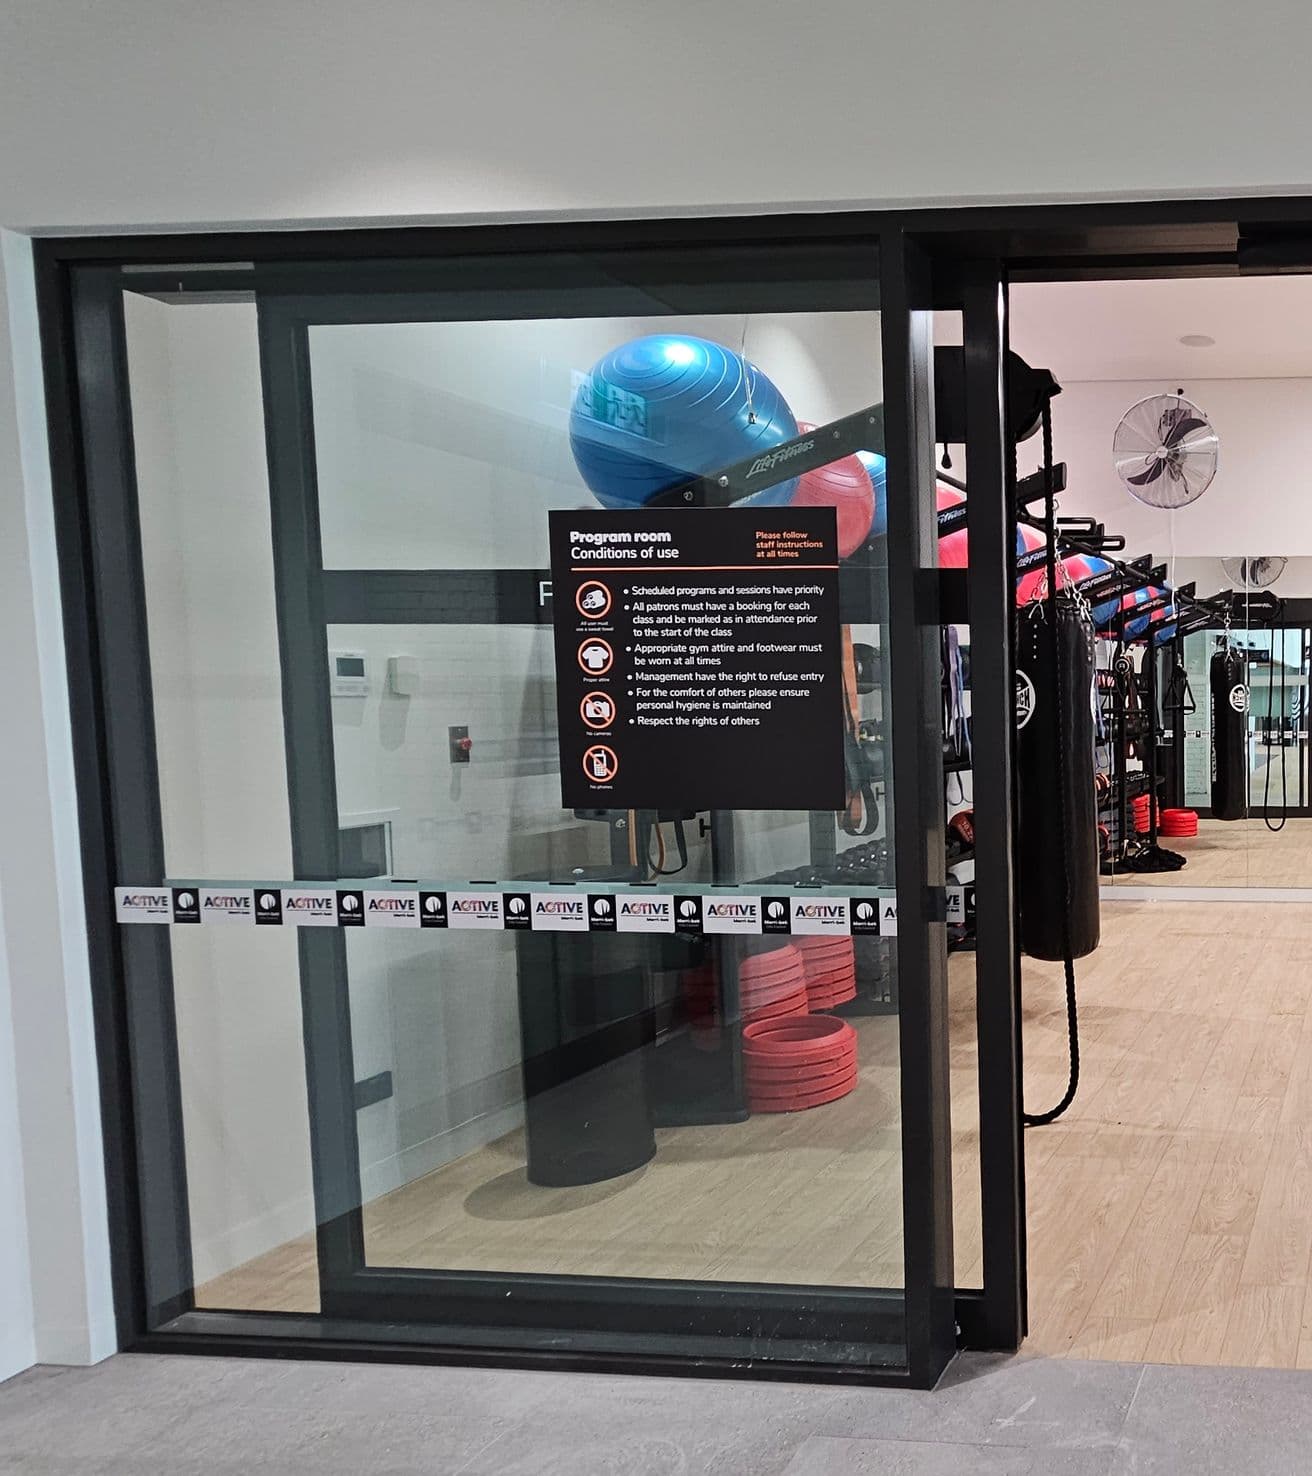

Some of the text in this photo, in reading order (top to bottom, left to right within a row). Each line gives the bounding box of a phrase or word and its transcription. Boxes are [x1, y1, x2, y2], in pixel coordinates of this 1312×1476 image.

[570, 531, 671, 545] Program room
[756, 531, 808, 539] Please follow
[776, 540, 823, 548] instructions
[571, 546, 679, 559] Conditions of use
[632, 585, 824, 597] Scheduled programs and sessions have priority
[632, 601, 810, 613] All patrons must have a booking for each
[633, 614, 818, 624] class and be marked as in attendance prior
[633, 627, 732, 637] to the start of the class
[634, 643, 822, 654] Appropriate gym attire and footwear must
[634, 656, 646, 665] be
[673, 657, 683, 665] at
[684, 656, 695, 665] all
[696, 656, 721, 665] times
[635, 671, 824, 683] Management have the right to refuse entry
[636, 687, 810, 699] For the comfort of others please ensure
[636, 700, 772, 712] personal hygiene is maintained
[637, 716, 760, 727] Respect the rights of others
[123, 895, 168, 906] ACTIVE
[204, 896, 250, 908] ACTIVE
[286, 897, 332, 909] ACTIVE
[368, 899, 415, 910] ACTIVE
[451, 900, 499, 912] ACTIVE
[536, 902, 583, 913] ACTIVE
[621, 903, 669, 914] ACTIVE
[708, 904, 756, 916] ACTIVE
[795, 905, 845, 917] ACTIVE
